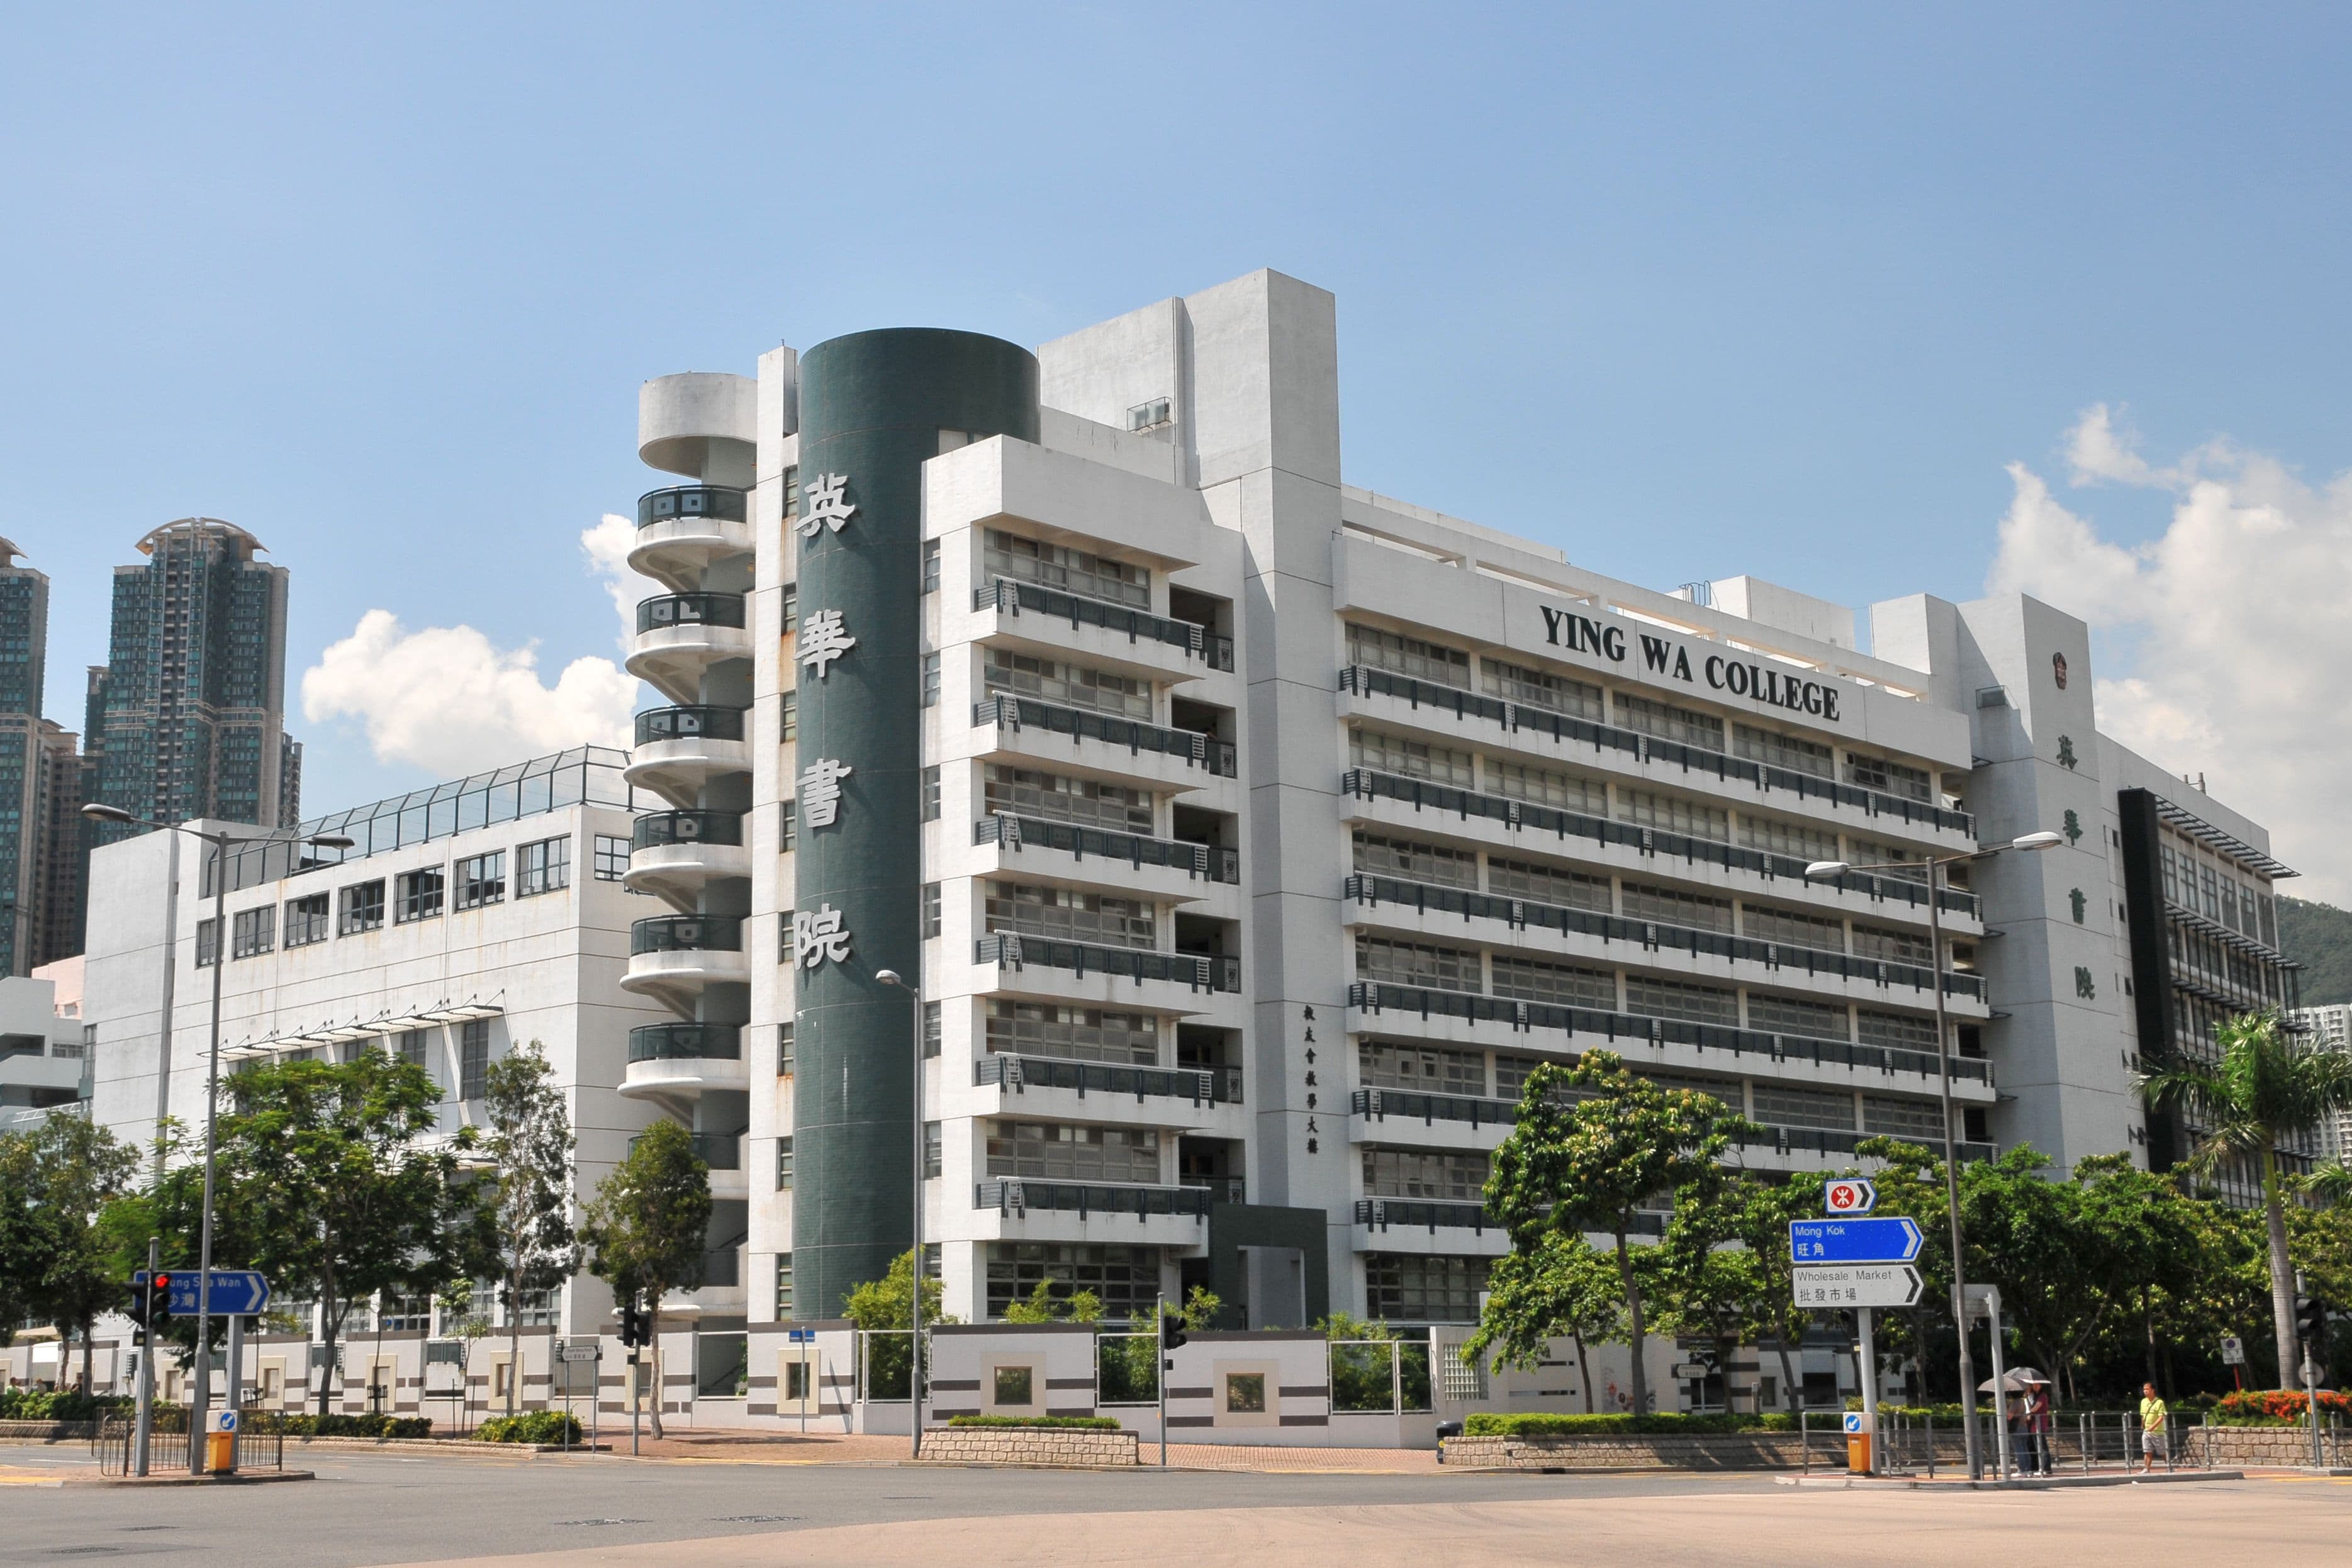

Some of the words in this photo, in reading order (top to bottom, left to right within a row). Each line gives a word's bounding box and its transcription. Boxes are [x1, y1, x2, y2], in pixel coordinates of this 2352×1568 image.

[1540, 605, 1626, 662] YING
[1639, 634, 1693, 683] WA
[1705, 655, 1840, 722] COLLEGE
[793, 473, 856, 970] 英華書院
[2056, 734, 2096, 1001] 英華書院
[1795, 1226, 1822, 1238] Mong
[1827, 1224, 1845, 1235] Kok
[1797, 1242, 1824, 1257] 旺角
[193, 1277, 214, 1287] Sa
[218, 1277, 241, 1287] Wan
[1797, 1271, 1849, 1281] Wholesale
[1856, 1270, 1892, 1280] Market
[168, 1292, 195, 1308] 沙灣
[1800, 1288, 1856, 1301] 批發市場
